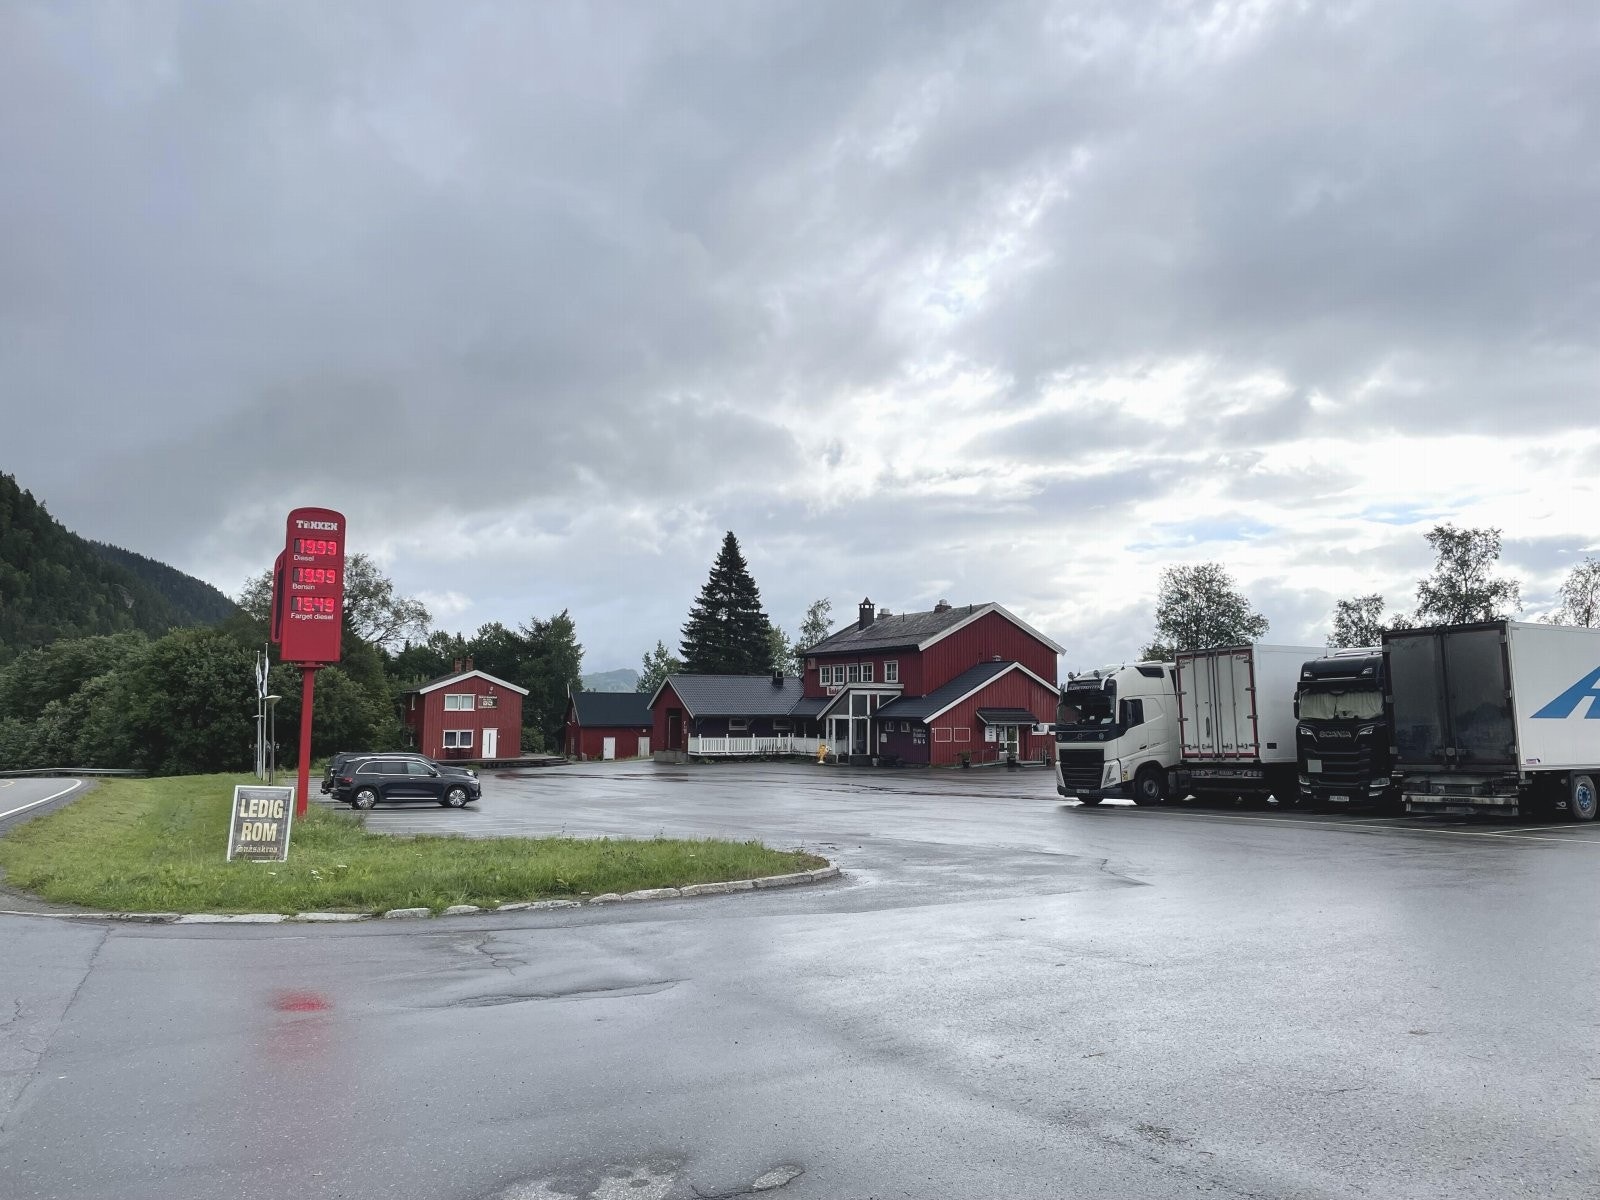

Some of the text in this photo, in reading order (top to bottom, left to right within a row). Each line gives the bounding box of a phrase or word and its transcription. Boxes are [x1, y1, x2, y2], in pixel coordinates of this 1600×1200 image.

[290, 612, 313, 621] Farget
[1319, 730, 1352, 738] SCANIA
[240, 799, 284, 818] LEDIG
[241, 822, 277, 841] ROM
